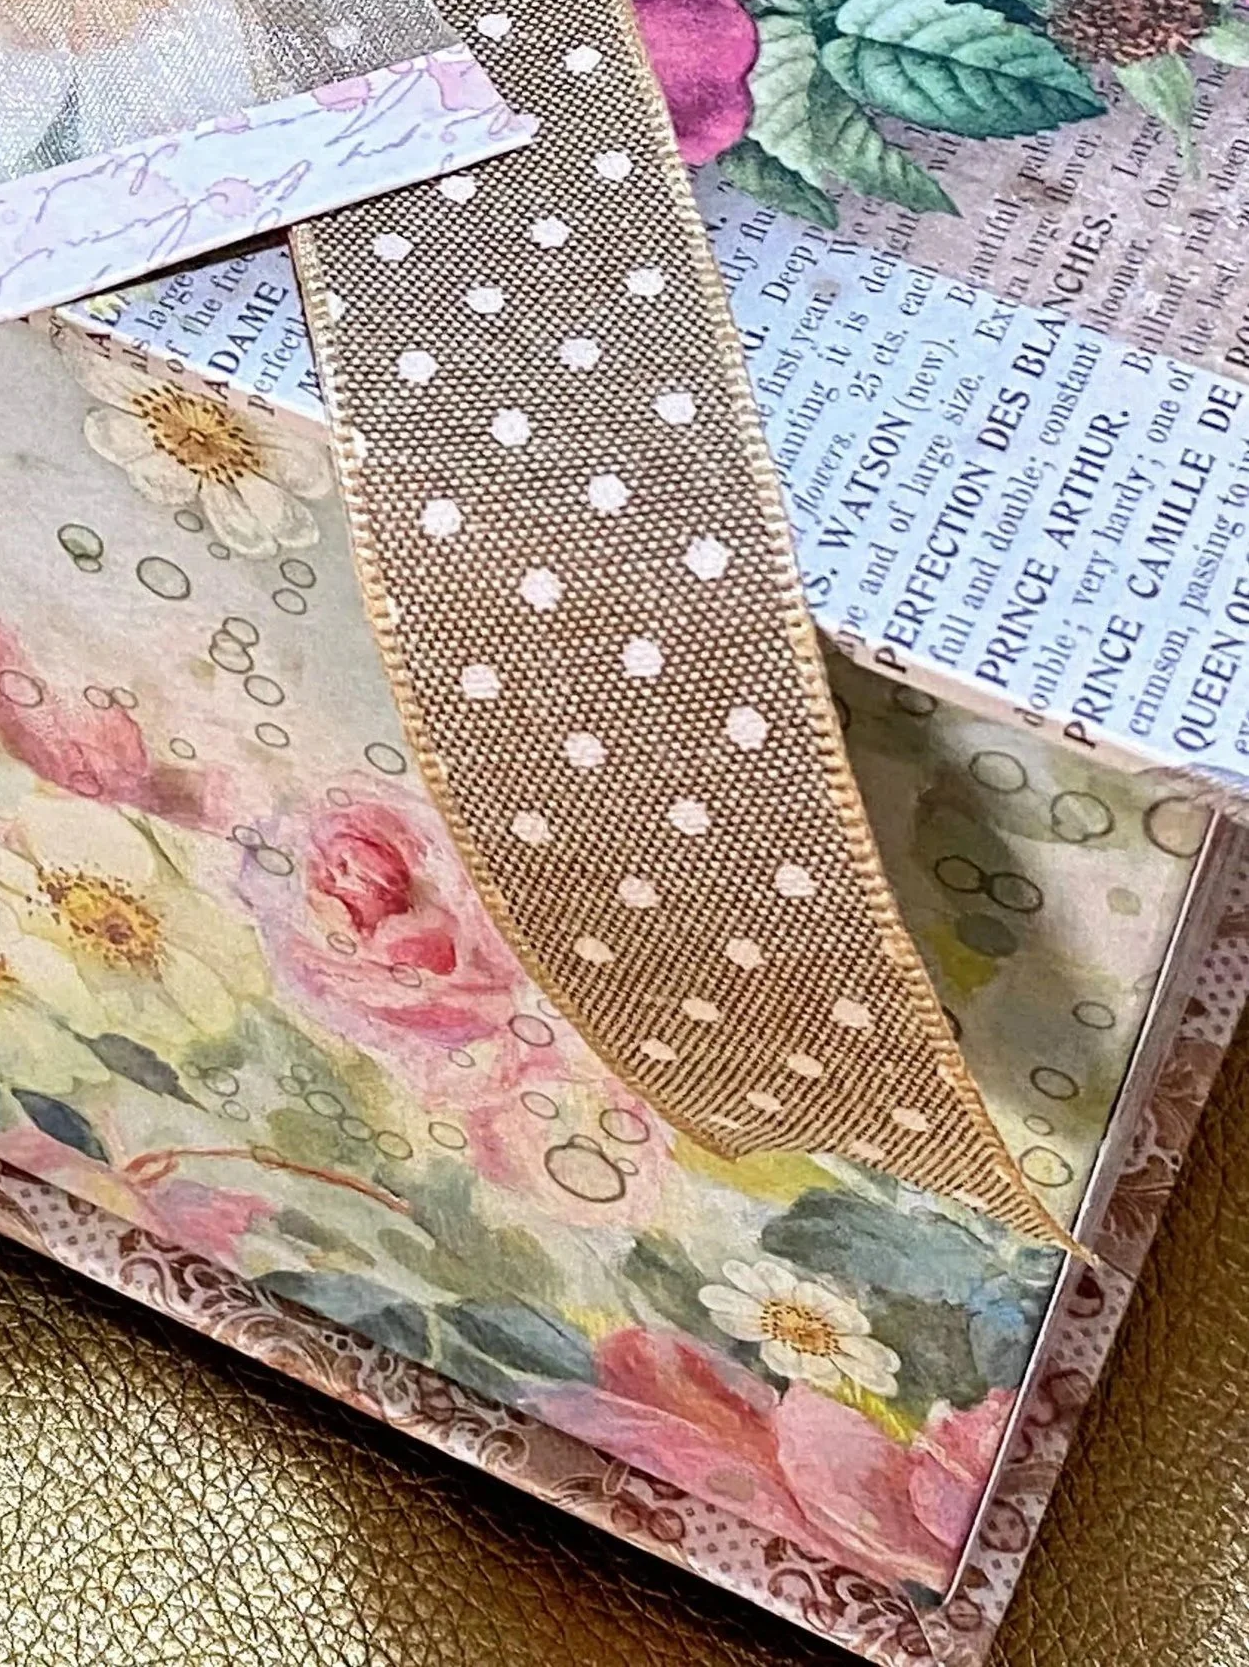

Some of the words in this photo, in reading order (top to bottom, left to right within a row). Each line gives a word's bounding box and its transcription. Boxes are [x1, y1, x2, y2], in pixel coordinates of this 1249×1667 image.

[1011, 203, 1061, 268] large
[759, 245, 818, 305] Deep
[817, 346, 852, 366] it
[835, 311, 868, 333] is
[973, 275, 1031, 345] Extra
[1179, 318, 1213, 356] the
[849, 370, 883, 402] 25
[938, 375, 985, 426] size.
[1167, 360, 1195, 392] of
[873, 460, 995, 675] PERFECTION
[975, 387, 1031, 453] DES
[1011, 212, 1118, 379] BLANCHES.
[1147, 400, 1180, 444] one
[817, 410, 912, 548] WATSON
[897, 434, 954, 497] large
[888, 500, 916, 533] of
[928, 614, 976, 667] full
[963, 556, 1001, 611] and
[1039, 343, 1102, 446] constant
[859, 541, 899, 596] and
[975, 558, 1060, 688] PRINCE
[1043, 410, 1129, 550] ARTHUR.
[1062, 614, 1144, 750] PRINCE
[1127, 448, 1216, 599] CAMILLE
[1197, 384, 1243, 433] DE
[1072, 550, 1115, 605] very
[1129, 626, 1200, 737] crimson,
[1179, 513, 1246, 617] passing
[1216, 483, 1249, 508] to
[1173, 630, 1246, 752] QUEEN
